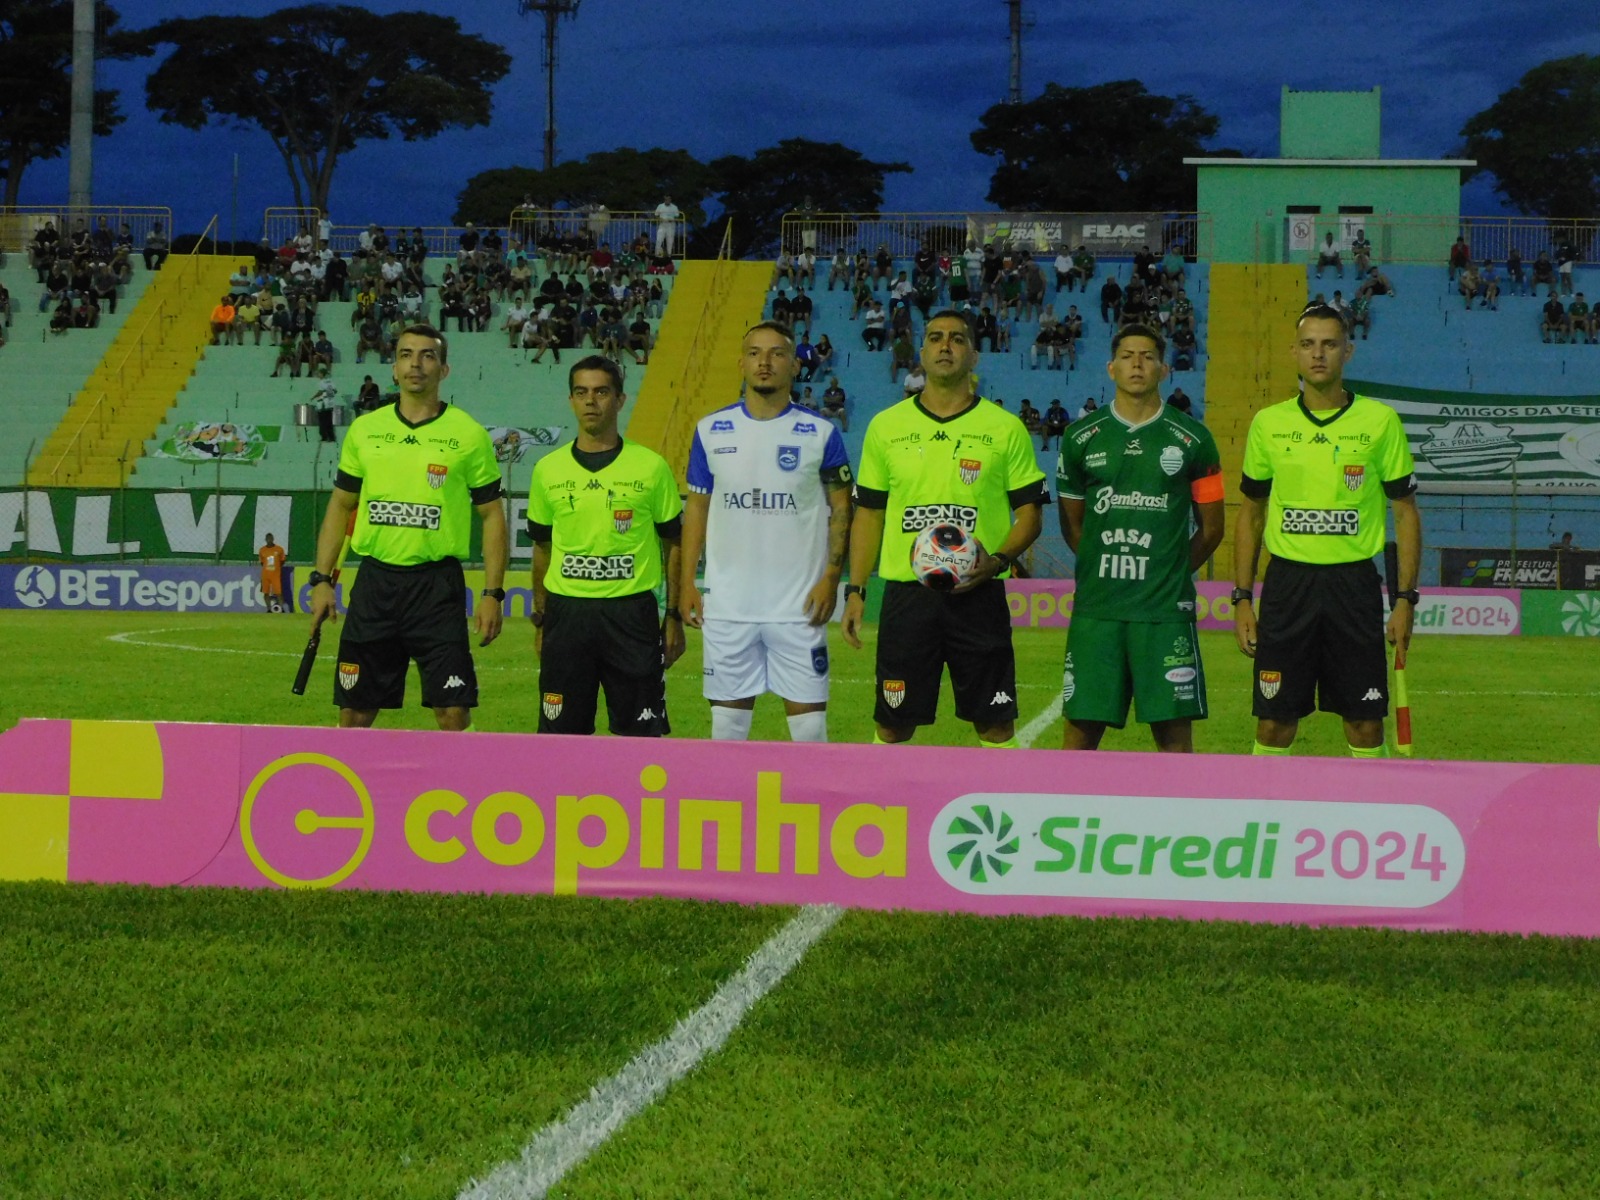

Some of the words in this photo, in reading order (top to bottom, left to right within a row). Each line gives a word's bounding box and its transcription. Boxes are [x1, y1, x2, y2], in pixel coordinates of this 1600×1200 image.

[1082, 225, 1146, 237] FEAC
[1439, 406, 1519, 417] AMIGOS
[1525, 407, 1553, 416] DA
[430, 465, 445, 473] FPF
[369, 502, 441, 518] ODONTO
[903, 505, 977, 520] ODONTO
[1283, 510, 1358, 523] ODONTO
[369, 513, 439, 529] company
[1282, 520, 1357, 534] company
[1101, 528, 1152, 549] CASA
[562, 555, 634, 569] ODONTO
[921, 553, 971, 564] PENALTY
[561, 568, 634, 580] company
[1098, 554, 1149, 580] FIAT
[1452, 606, 1511, 626] 2024
[404, 764, 908, 895] copinha
[1034, 816, 1280, 879] Sicredi
[1294, 828, 1446, 882] 2024
